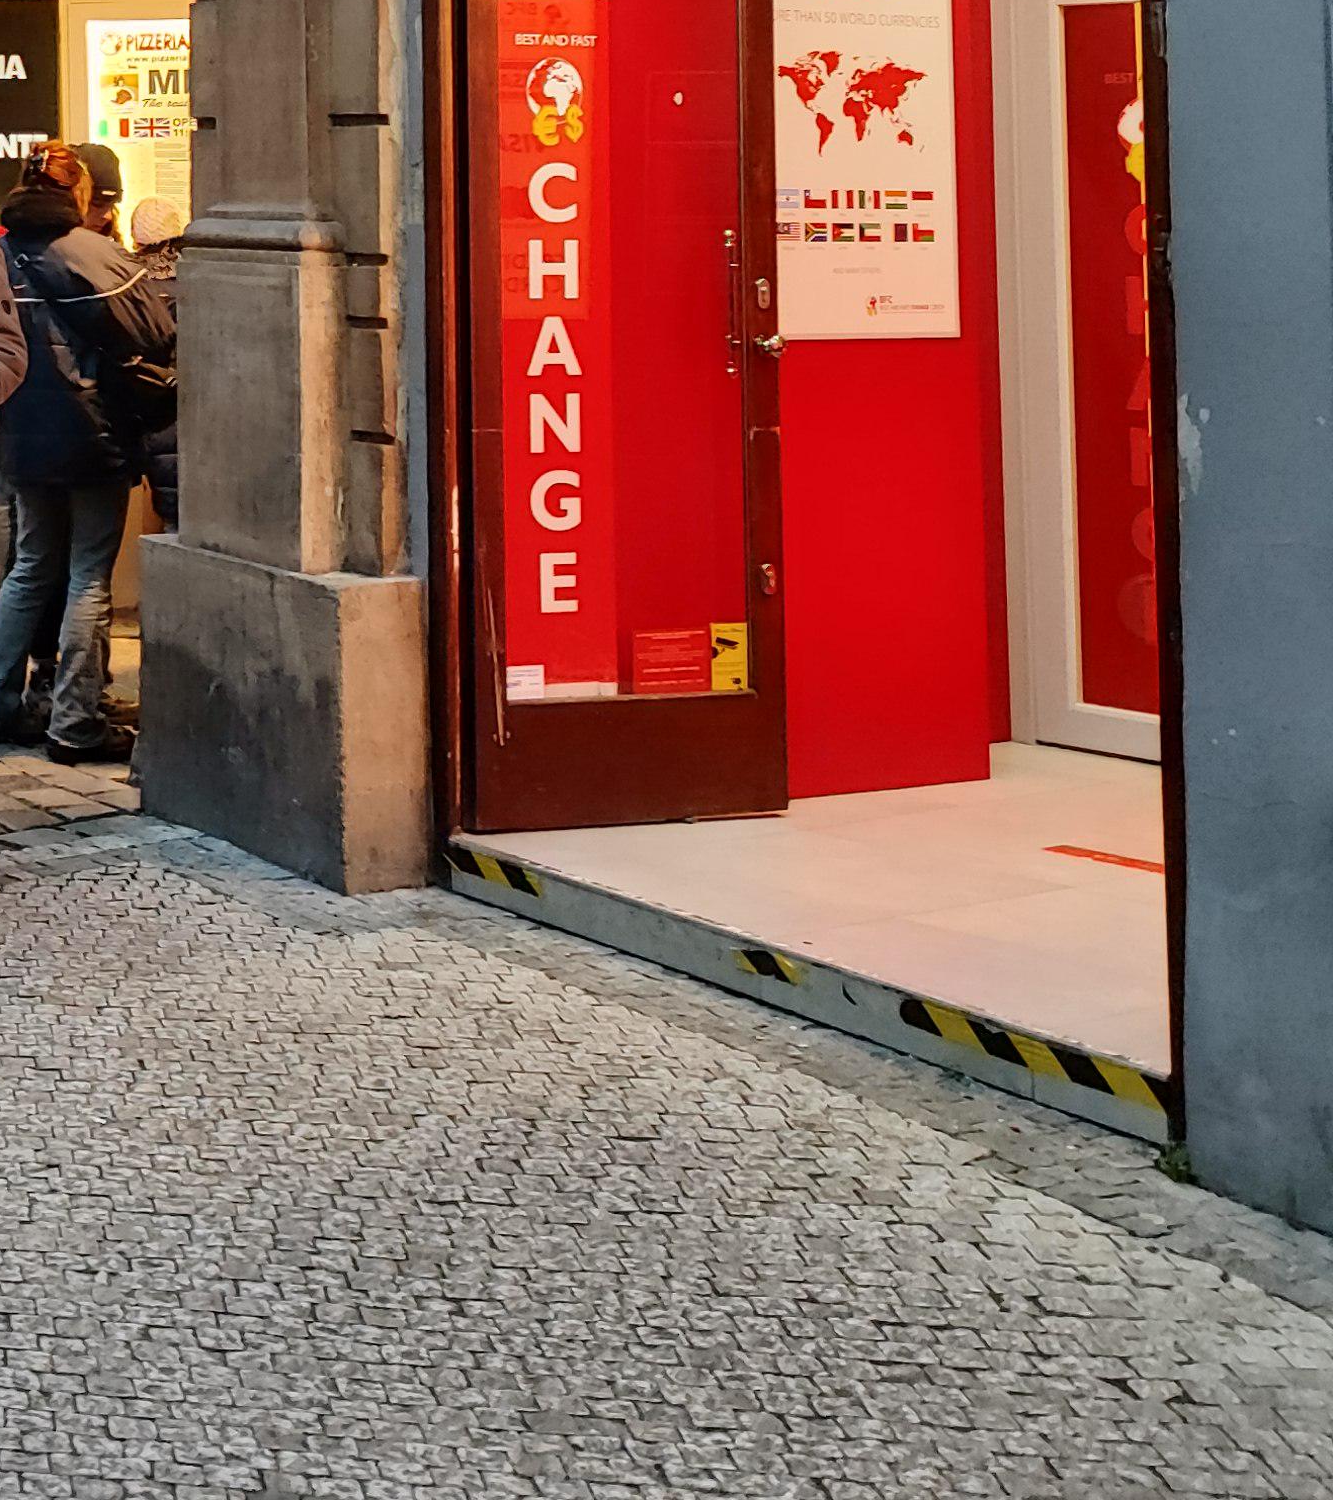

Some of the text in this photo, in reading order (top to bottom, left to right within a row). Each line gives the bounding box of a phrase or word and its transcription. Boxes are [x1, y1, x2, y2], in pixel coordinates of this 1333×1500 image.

[126, 33, 190, 51] PIZZERIA
[514, 33, 598, 47] BEST AND FAST
[526, 161, 583, 614] CHANGE
